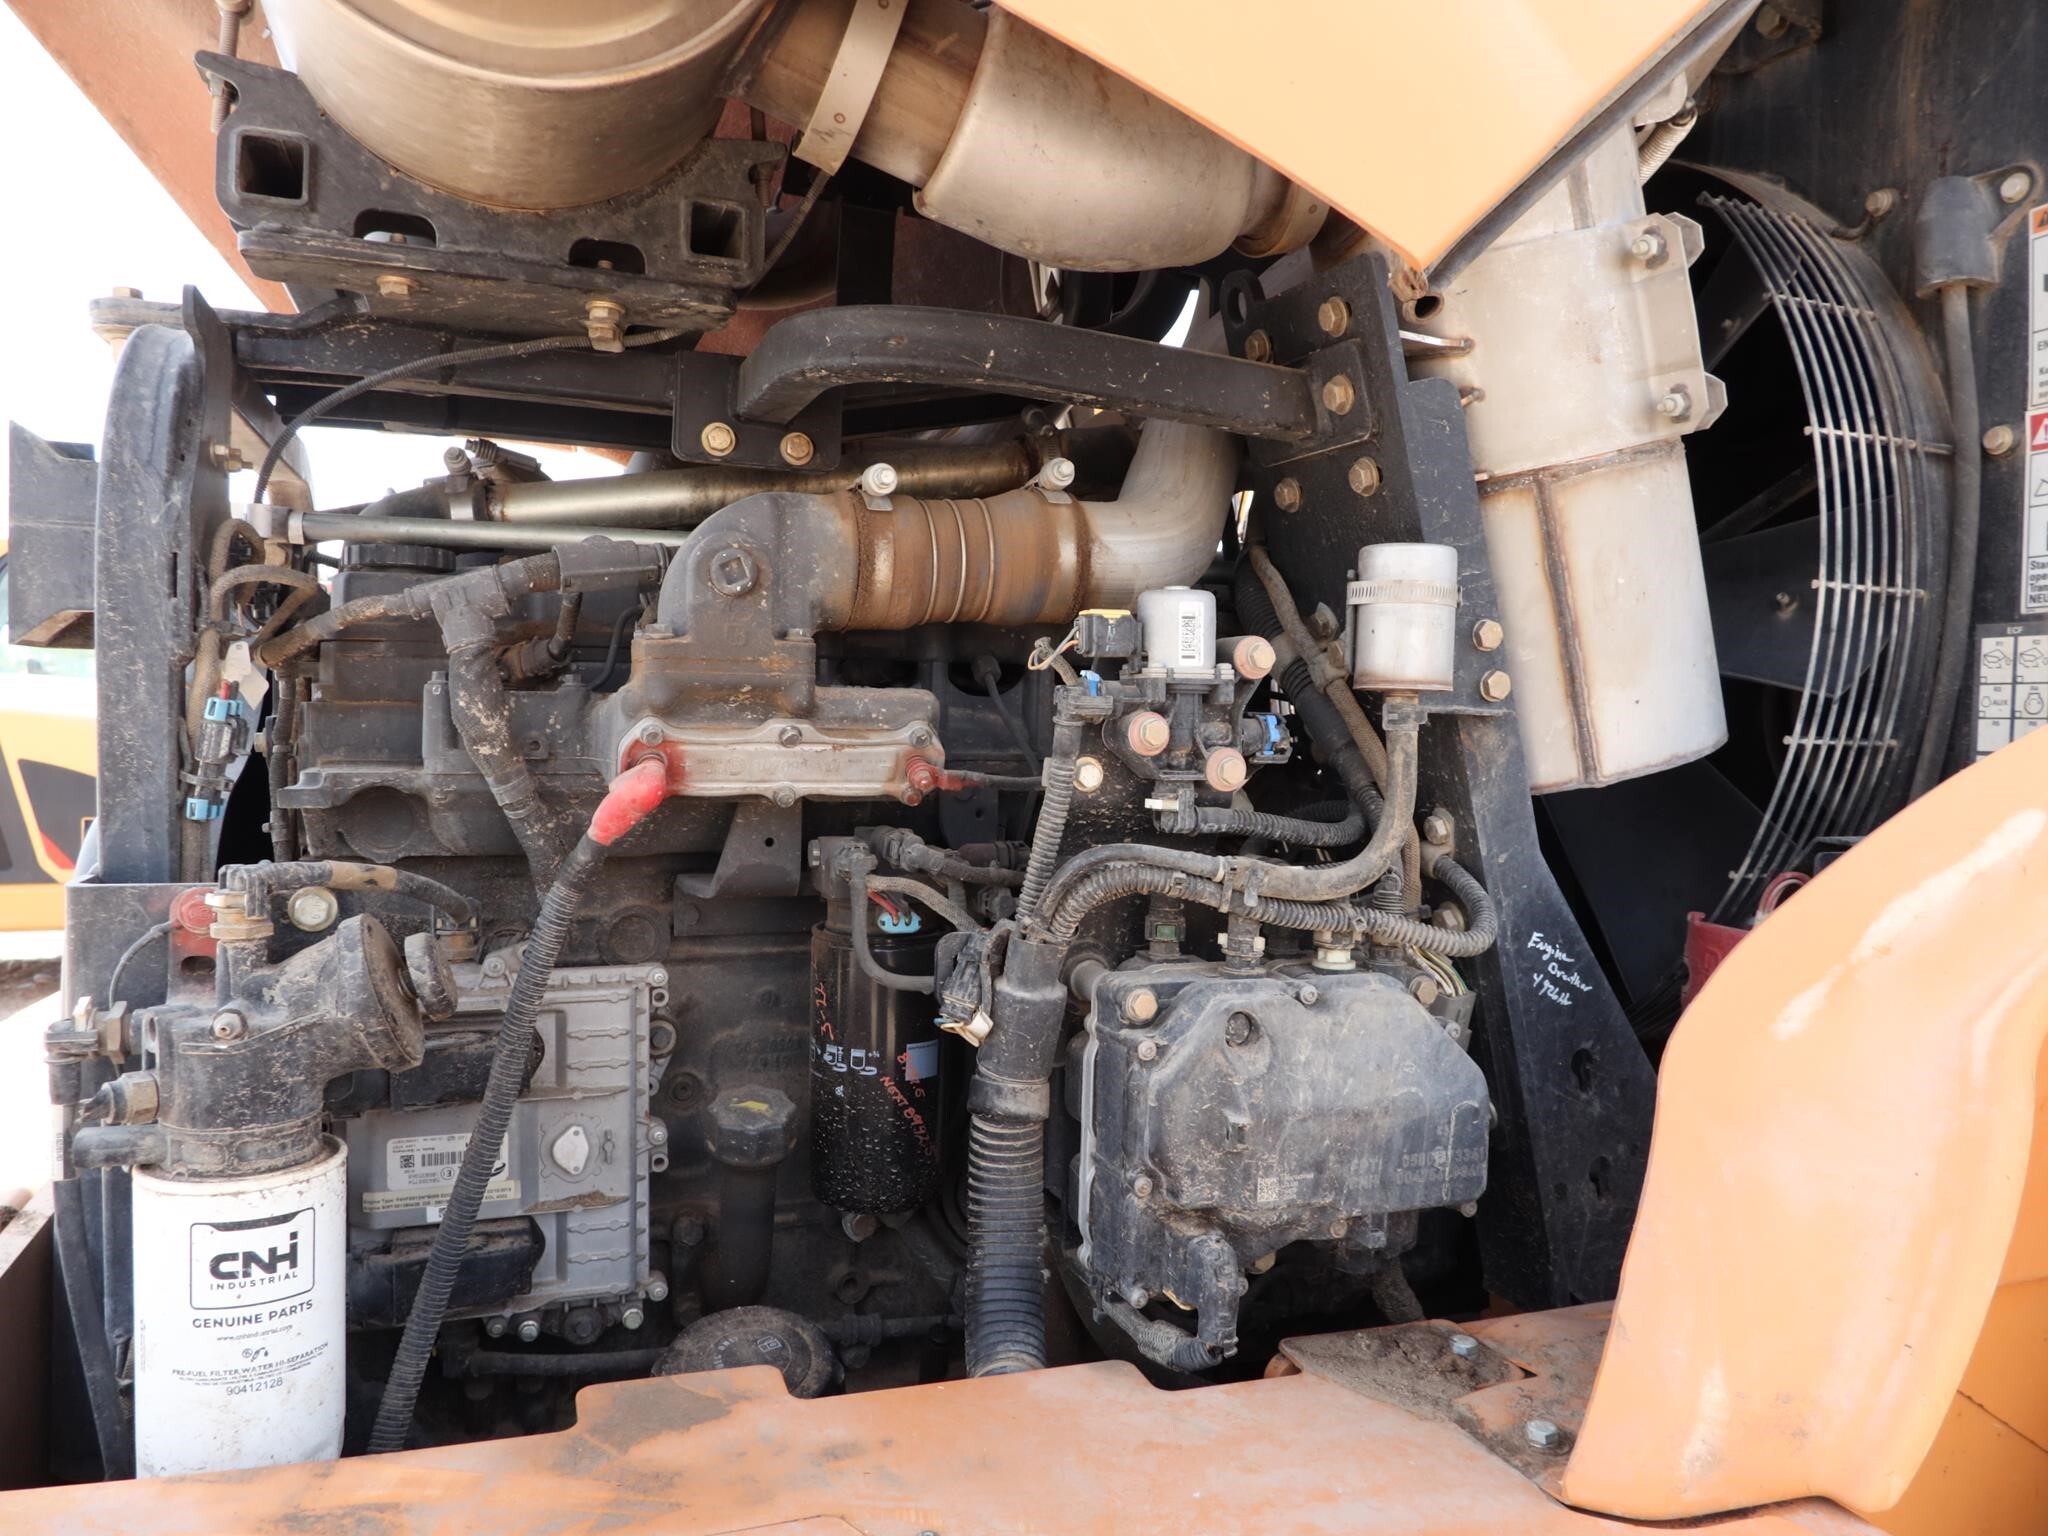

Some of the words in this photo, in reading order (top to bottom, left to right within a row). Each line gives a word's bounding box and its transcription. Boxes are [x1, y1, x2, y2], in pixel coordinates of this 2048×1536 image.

[210, 1271, 298, 1291] INDUSTRIAL
[192, 1313, 263, 1328] GENUINE
[268, 1299, 313, 1321] PARTS
[242, 1362, 273, 1374] WATER
[226, 1376, 284, 1397] 90412128
